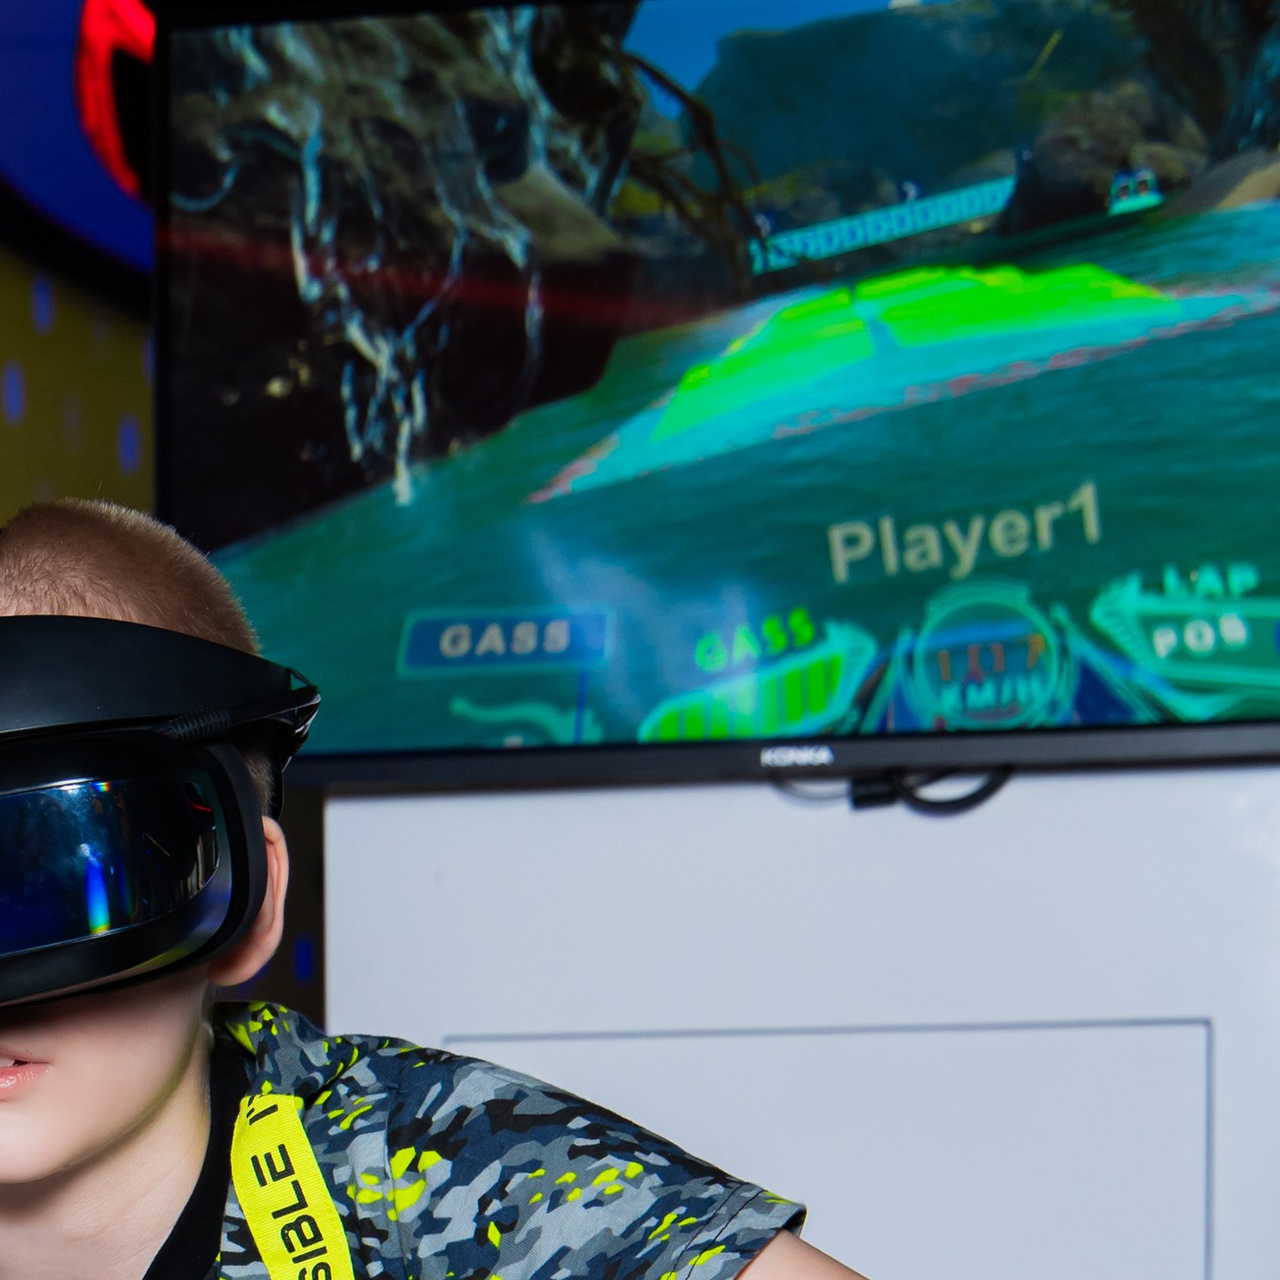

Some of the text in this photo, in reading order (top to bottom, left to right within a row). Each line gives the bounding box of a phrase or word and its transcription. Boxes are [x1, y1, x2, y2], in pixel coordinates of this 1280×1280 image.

[827, 482, 1101, 584] Player1
[439, 619, 572, 659] GASS
[695, 607, 814, 673] GASS
